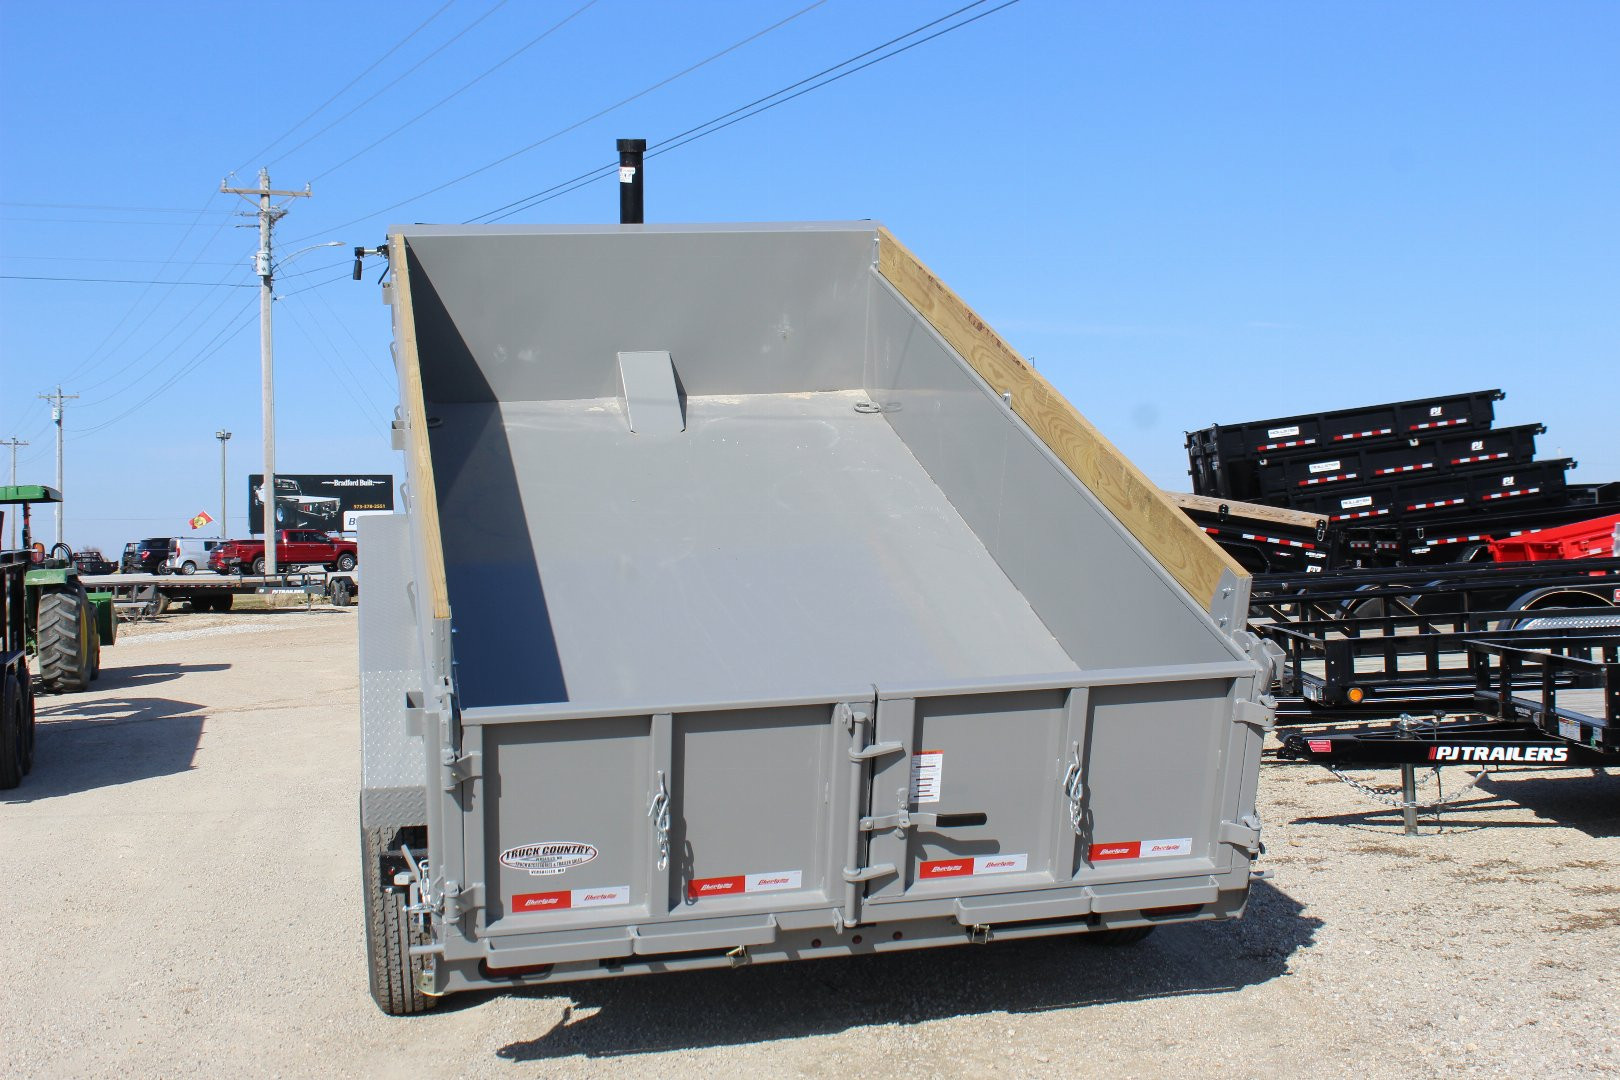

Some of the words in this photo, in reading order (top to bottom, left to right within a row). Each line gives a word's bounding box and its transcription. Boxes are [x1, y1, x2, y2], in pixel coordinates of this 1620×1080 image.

[333, 479, 359, 487] Bradford
[1461, 746, 1569, 762] TRAILERS
[505, 847, 541, 860] TRUCK
[542, 845, 591, 855] COUNTRY
